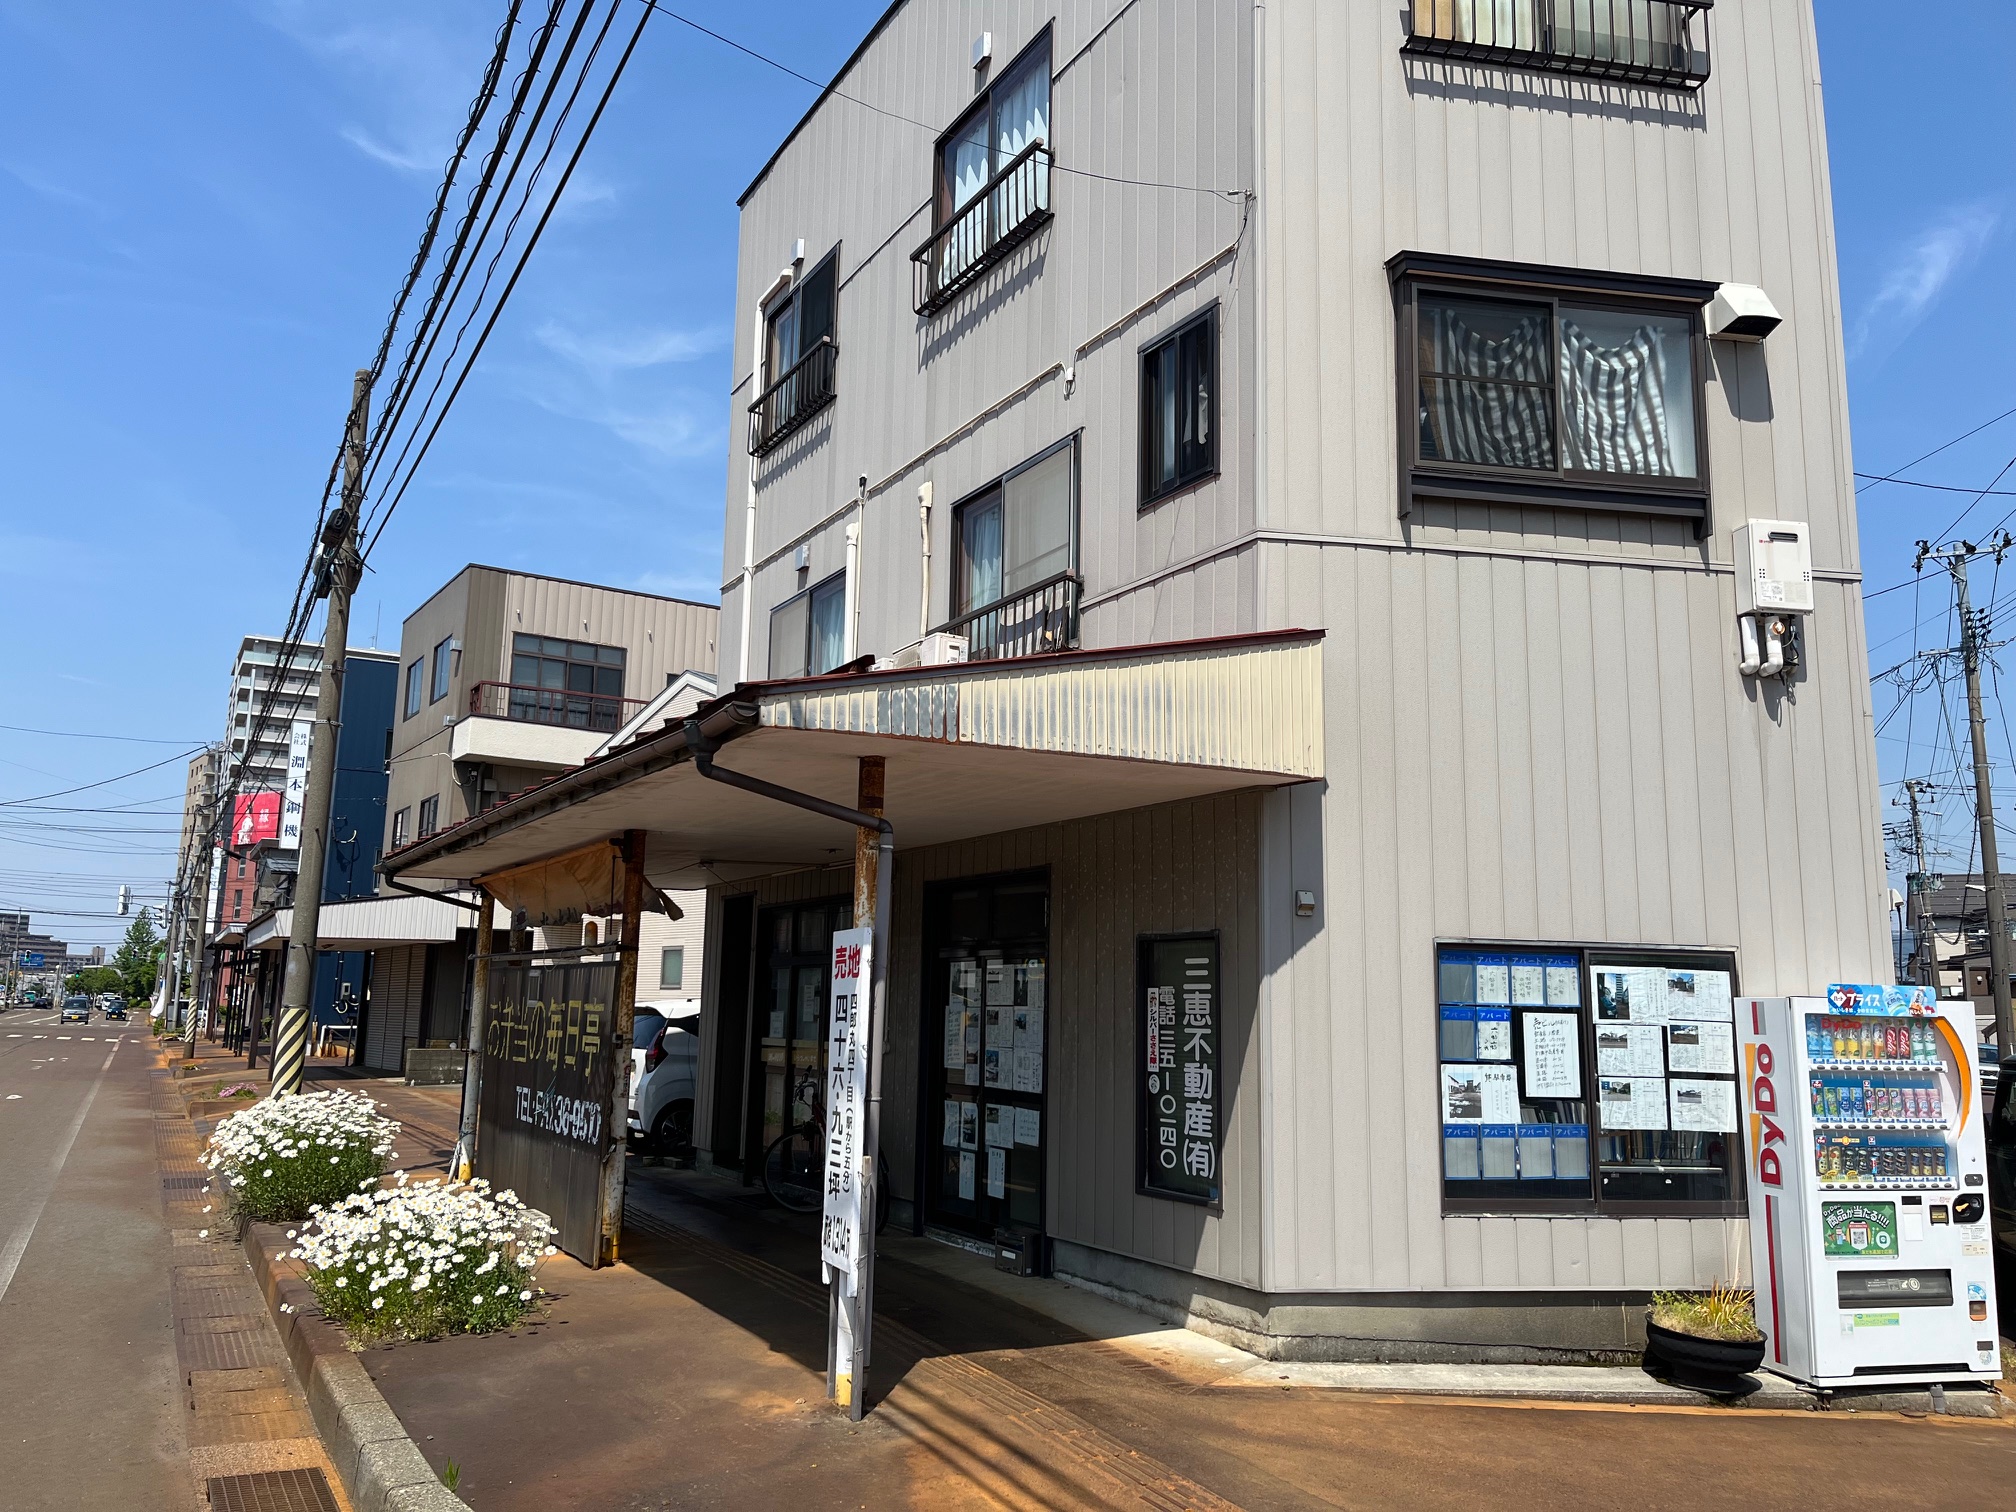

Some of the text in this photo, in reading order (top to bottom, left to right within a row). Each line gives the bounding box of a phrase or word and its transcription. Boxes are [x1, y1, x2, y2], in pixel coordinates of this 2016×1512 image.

[834, 944, 861, 980] 売地
[1477, 956, 1508, 966] アパート
[1512, 956, 1543, 966] アパート
[1546, 956, 1577, 967] アパート
[1846, 992, 1880, 1007] プライス
[1443, 1010, 1473, 1020] アパート
[1480, 1011, 1510, 1021] アパート
[487, 996, 605, 1084] お弁当の毎日亭
[1182, 957, 1216, 1180] 三恵不動産(有)
[1754, 1043, 1784, 1186] DyDo
[1445, 1128, 1476, 1137] アパート
[1483, 1128, 1514, 1137] アパート
[1520, 1128, 1550, 1137] アパート
[1555, 1128, 1587, 1138] アパート
